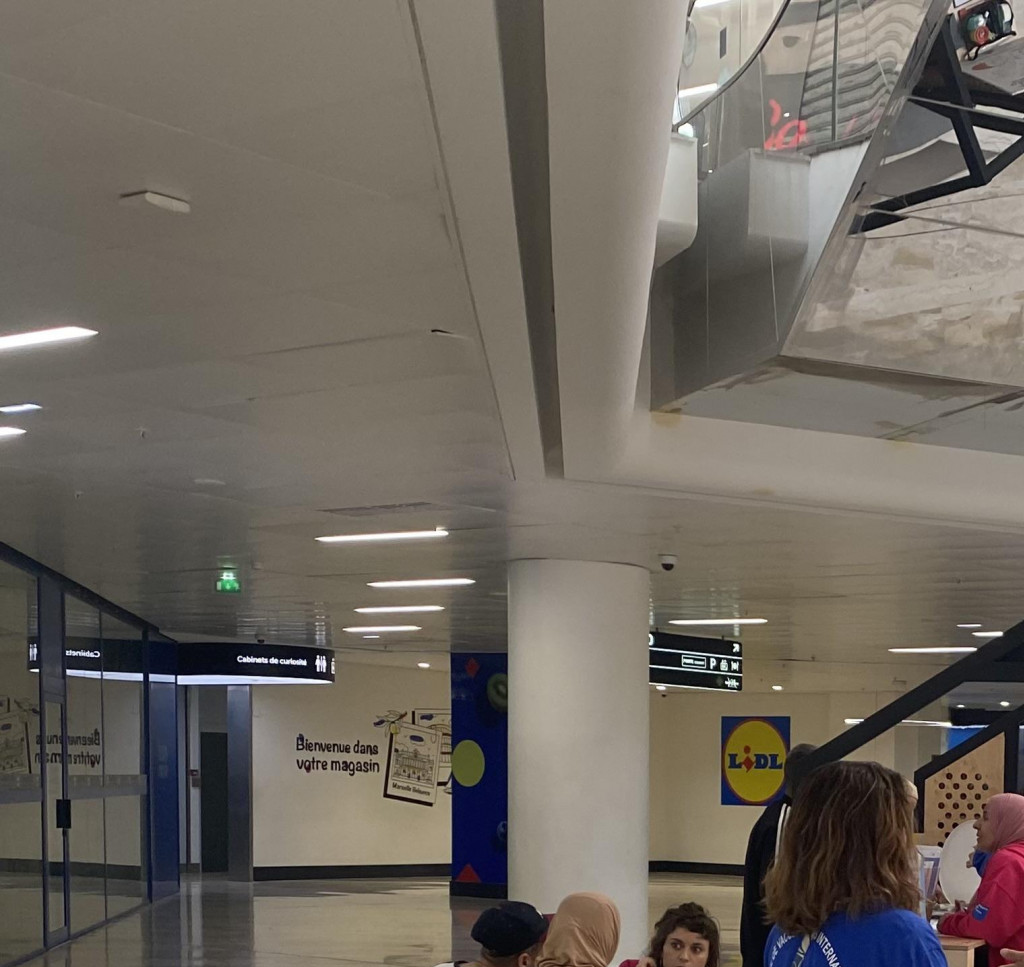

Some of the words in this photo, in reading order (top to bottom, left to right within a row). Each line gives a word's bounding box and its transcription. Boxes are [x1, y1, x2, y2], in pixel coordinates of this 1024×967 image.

[237, 655, 267, 665] Cabinets
[269, 656, 278, 665] de
[296, 734, 351, 754] Bienvenue
[353, 740, 379, 756] dans
[296, 757, 328, 773] votre
[330, 759, 380, 776] magasin
